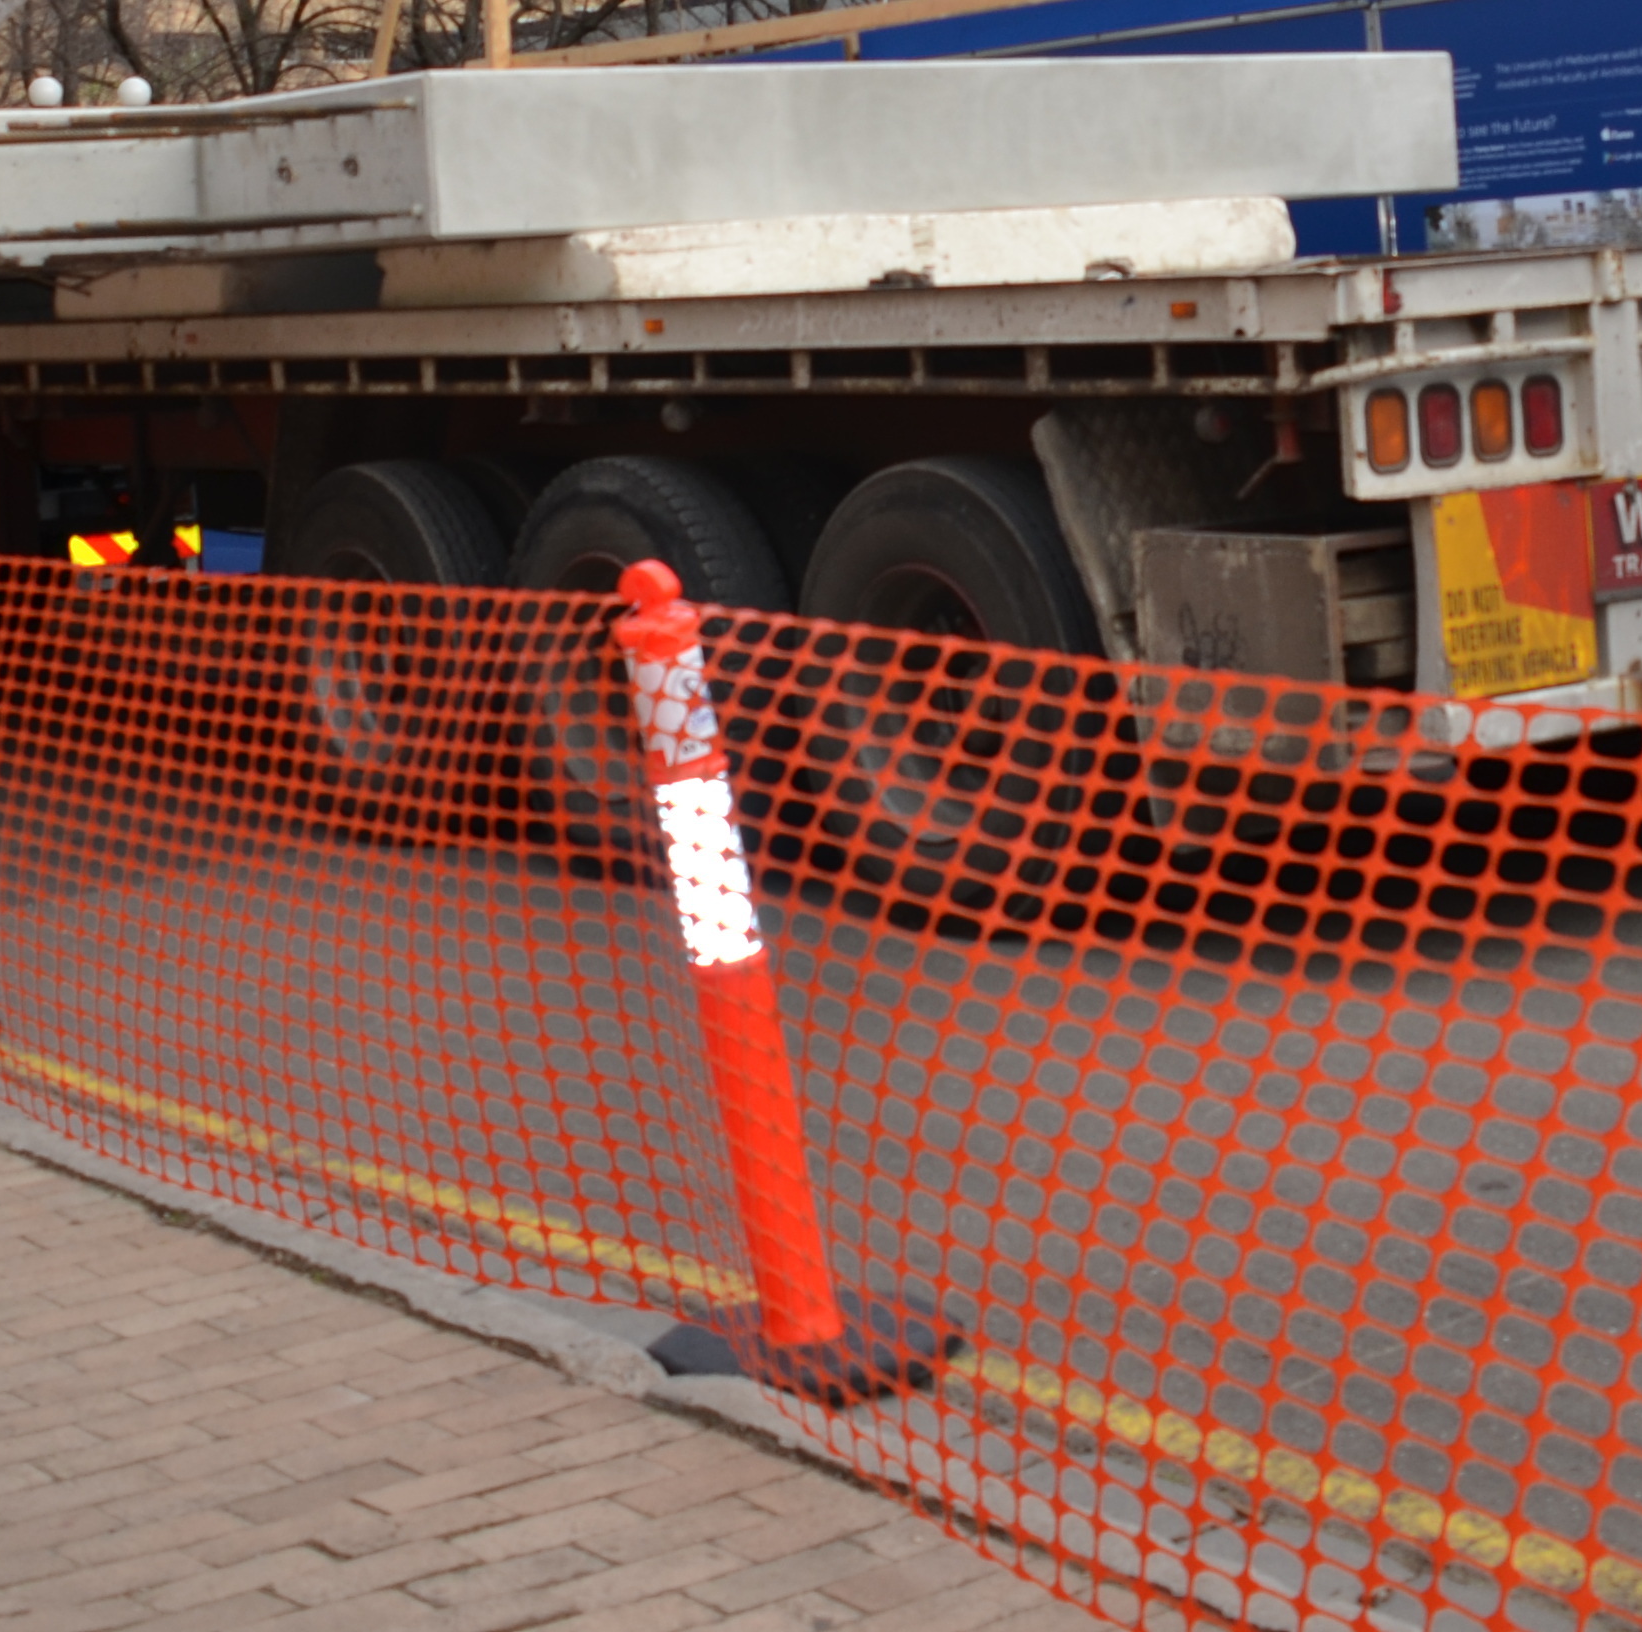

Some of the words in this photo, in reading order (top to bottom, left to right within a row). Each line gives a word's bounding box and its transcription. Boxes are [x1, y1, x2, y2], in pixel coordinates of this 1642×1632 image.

[1512, 58, 1553, 71] University
[1565, 51, 1610, 65] Melbourne
[1556, 69, 1588, 84] Faculty
[1490, 120, 1512, 136] the
[1513, 114, 1557, 133] future?
[1446, 589, 1468, 618] DO
[1473, 583, 1501, 613] NOT
[1450, 615, 1523, 654] OVERTAKE
[1453, 651, 1517, 689] TURNING
[1522, 642, 1578, 678] VEHICLE
